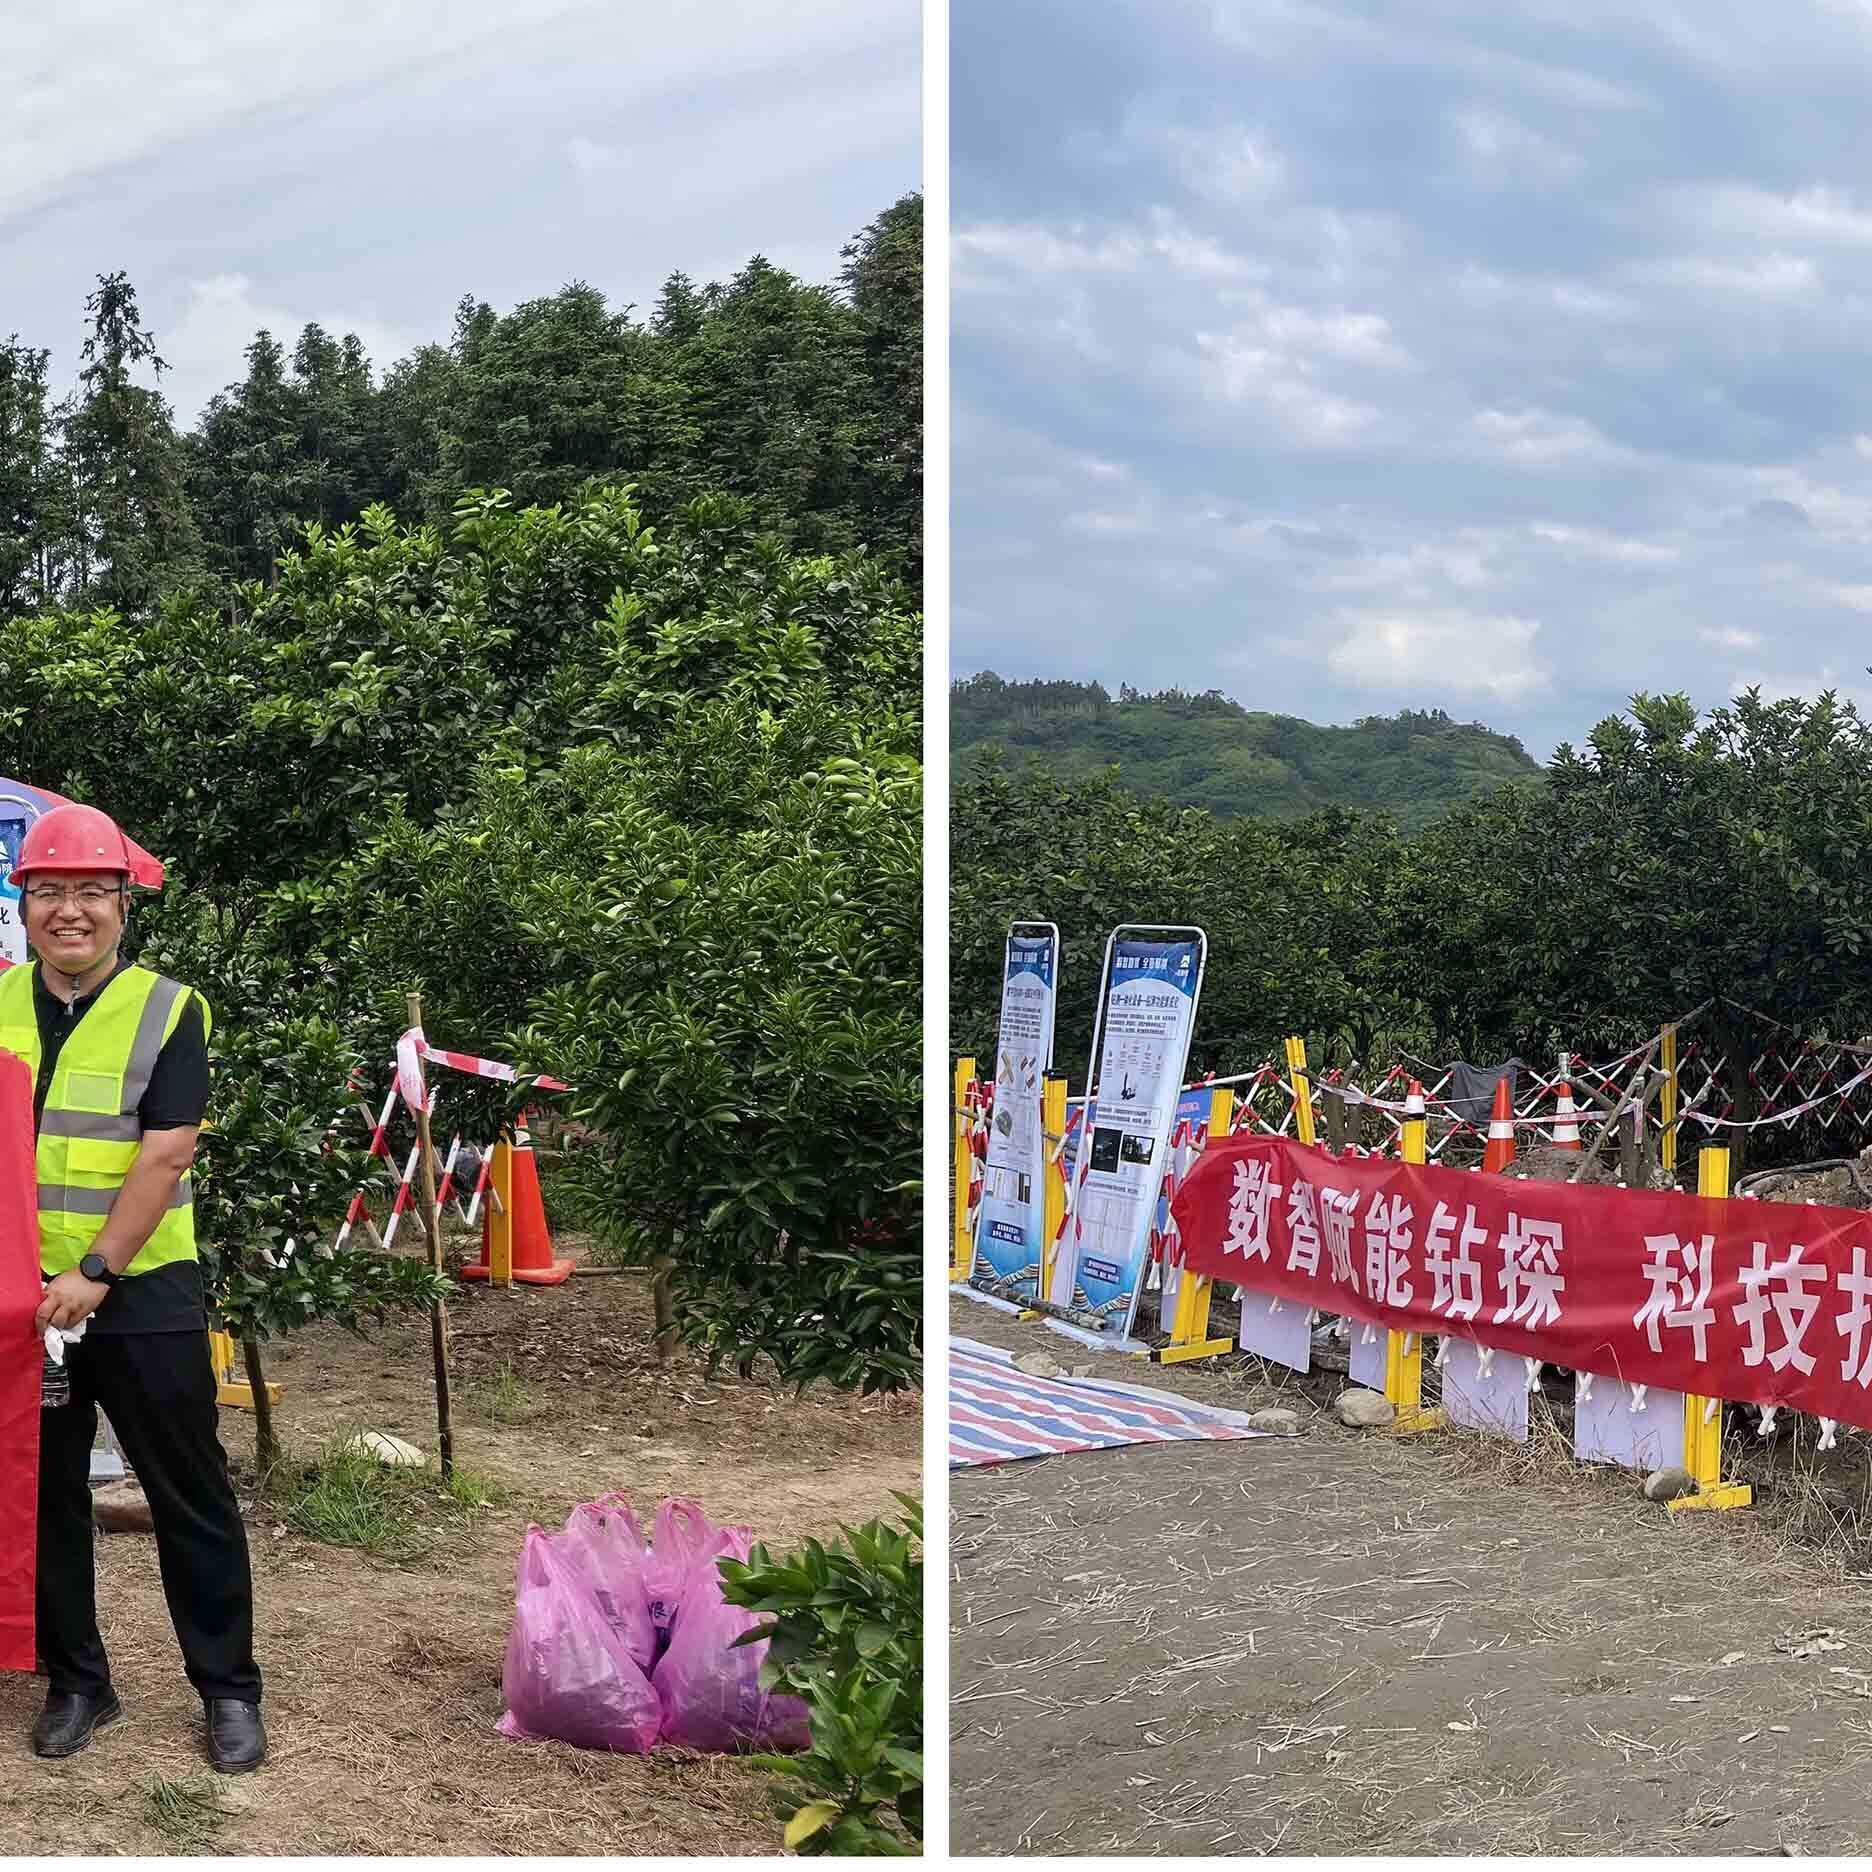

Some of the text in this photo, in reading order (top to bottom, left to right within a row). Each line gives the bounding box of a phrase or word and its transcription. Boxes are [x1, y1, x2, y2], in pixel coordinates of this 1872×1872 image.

[1223, 1159, 1565, 1332] 数智赋能钻探
